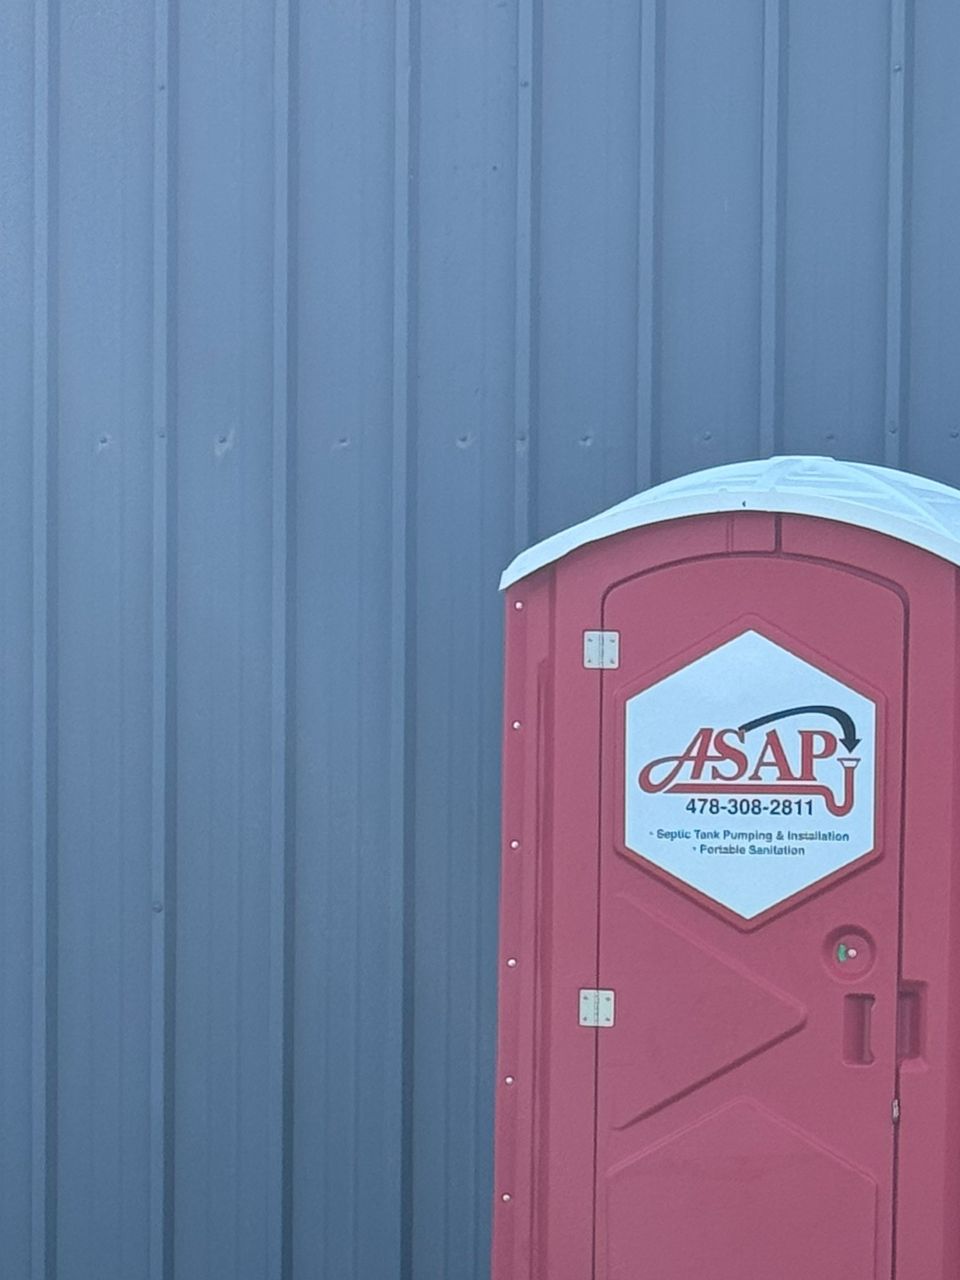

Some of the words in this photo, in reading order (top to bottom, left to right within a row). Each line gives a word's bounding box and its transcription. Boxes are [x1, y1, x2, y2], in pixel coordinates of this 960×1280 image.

[638, 728, 838, 794] ASAP
[685, 799, 814, 816] 478-308-2811
[656, 829, 691, 841] Septic
[693, 830, 720, 840] Tank
[723, 830, 773, 843] Pumping
[776, 831, 785, 842] &
[787, 831, 850, 842] Installation
[699, 845, 746, 856] Portable
[748, 845, 805, 856] Sanitation
